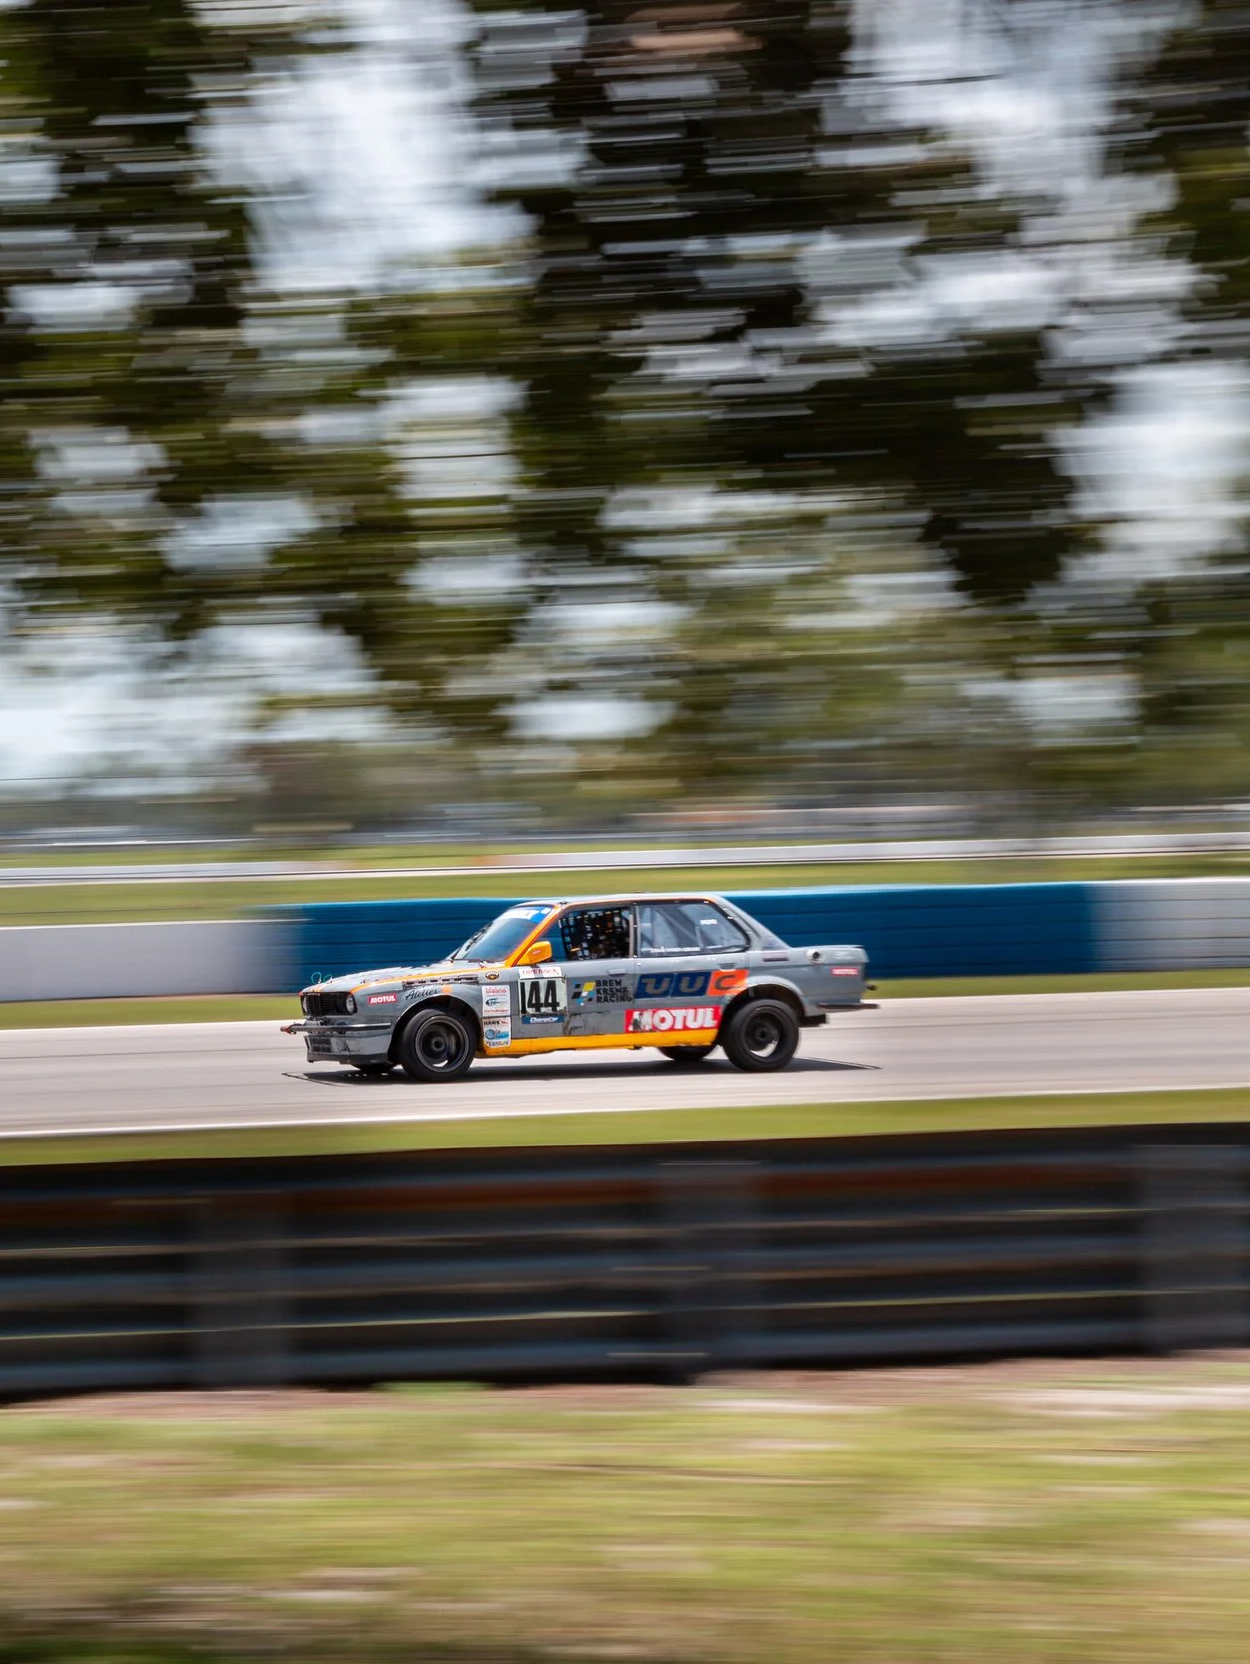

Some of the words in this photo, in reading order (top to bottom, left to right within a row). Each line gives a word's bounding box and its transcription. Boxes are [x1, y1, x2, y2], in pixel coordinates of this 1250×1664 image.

[641, 974, 744, 995] UUC
[370, 995, 396, 1004] MOTUL
[520, 980, 560, 1014] 144
[596, 994, 634, 1004] RACING
[628, 1007, 719, 1032] MOTUL
